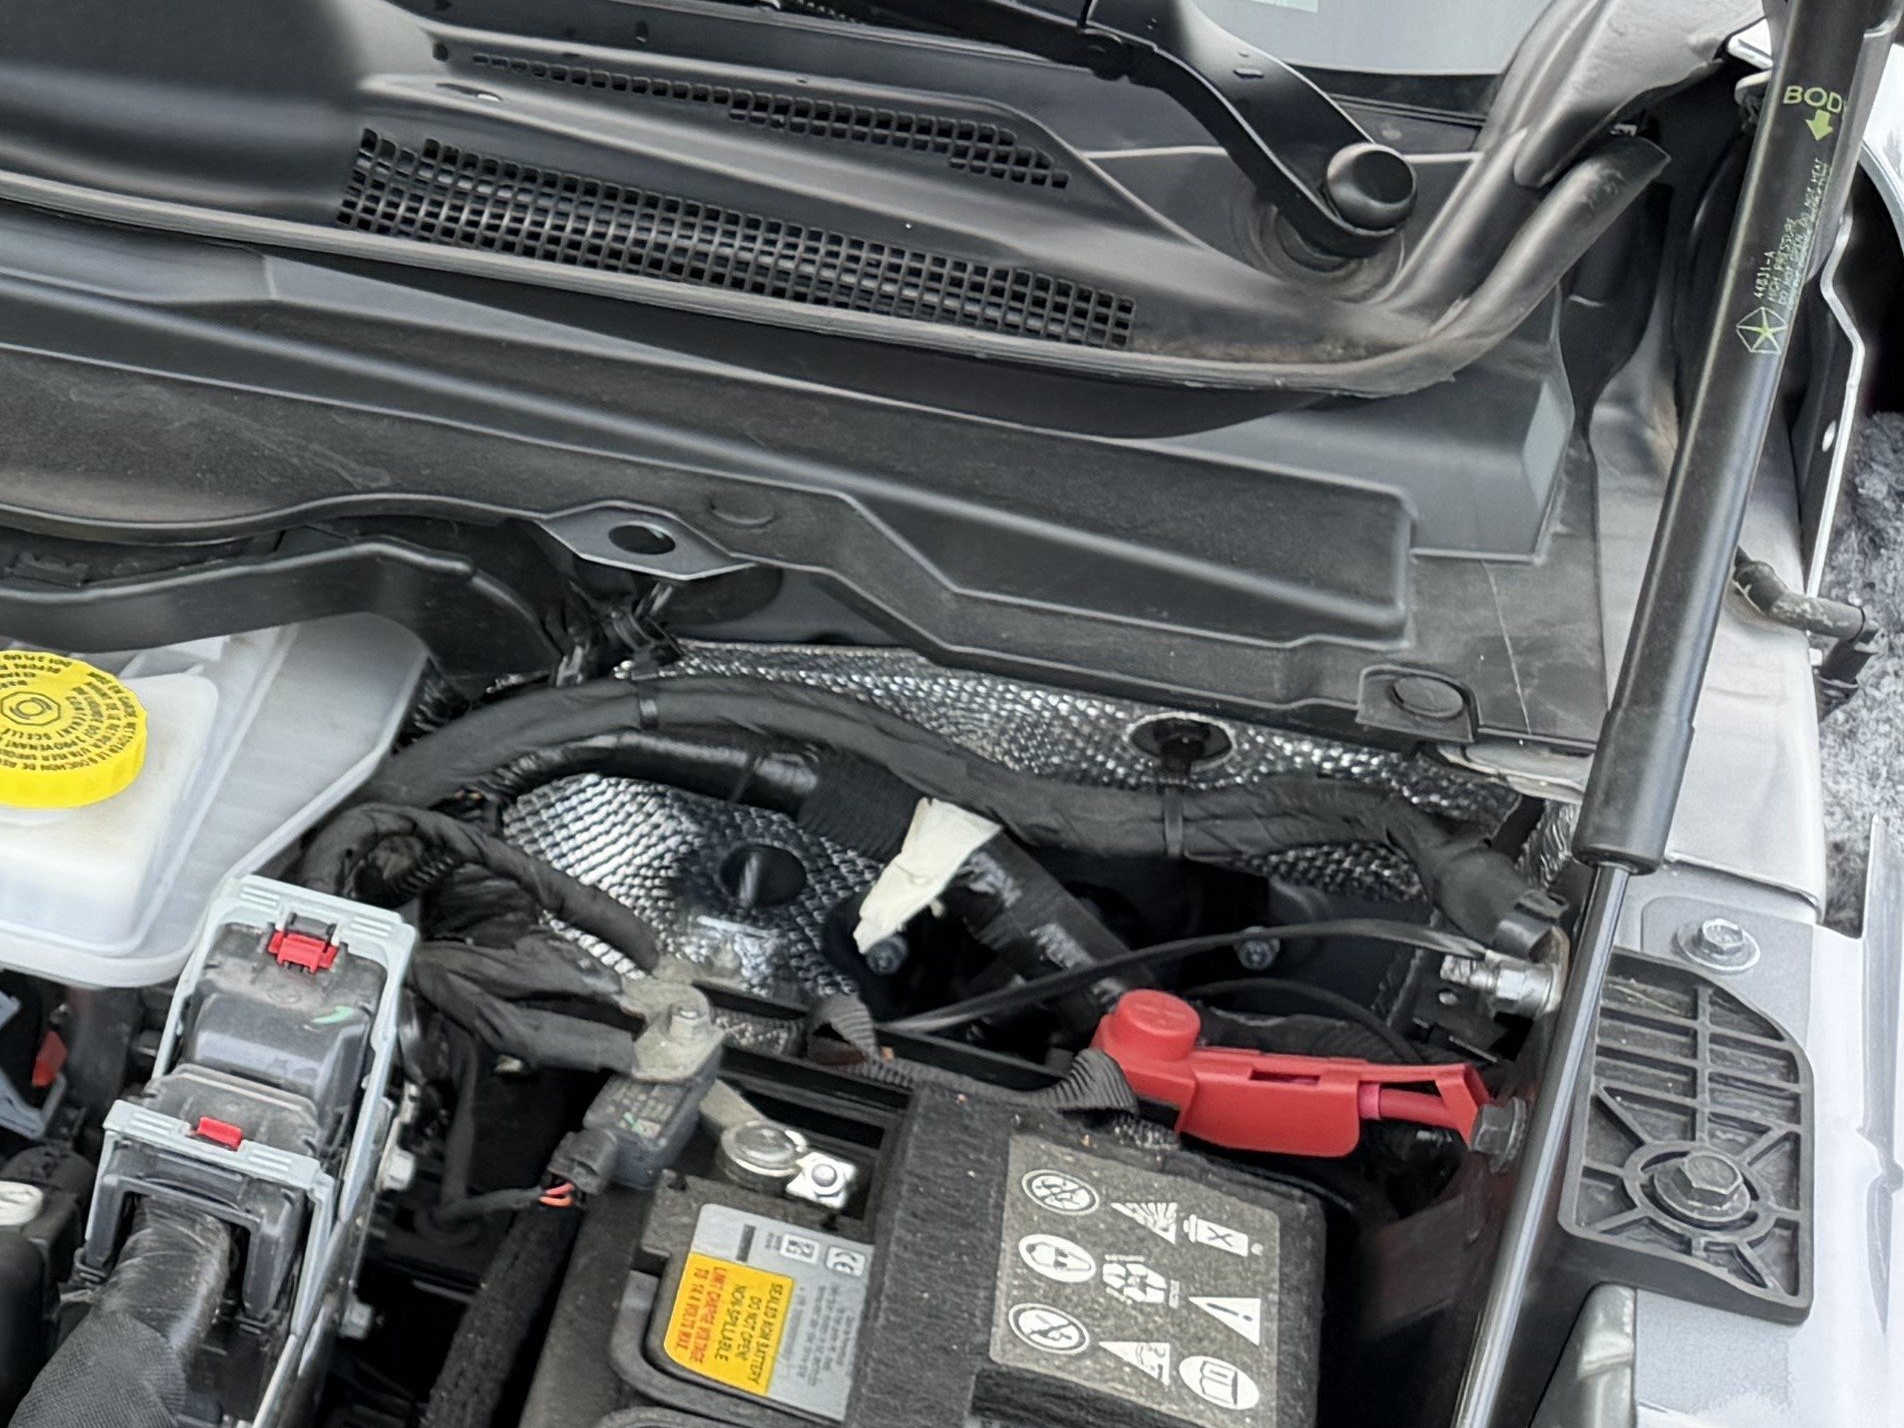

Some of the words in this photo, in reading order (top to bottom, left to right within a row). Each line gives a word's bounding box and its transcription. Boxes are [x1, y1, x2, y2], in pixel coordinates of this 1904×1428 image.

[1783, 85, 1843, 114] BOD
[744, 1311, 759, 1332] NOT
[747, 1338, 771, 1385] BATTERY
